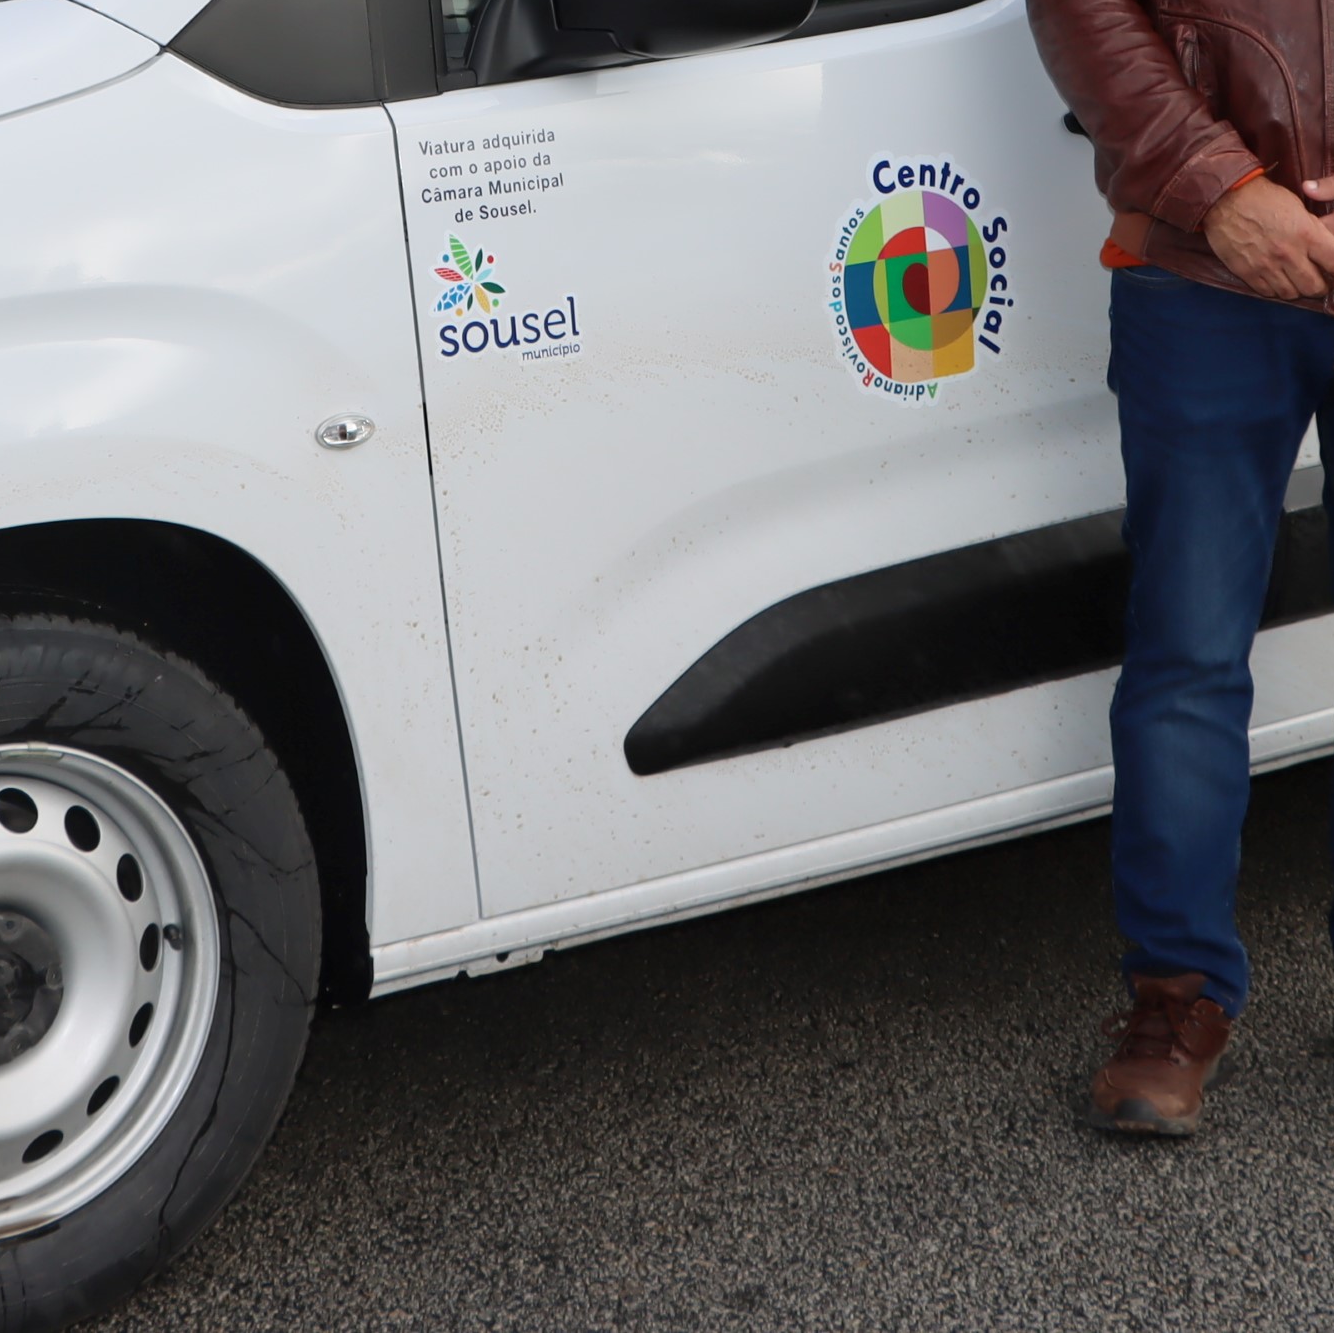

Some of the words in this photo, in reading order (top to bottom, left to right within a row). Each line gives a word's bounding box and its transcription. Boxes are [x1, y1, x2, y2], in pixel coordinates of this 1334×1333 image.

[419, 140, 475, 156] Viatura
[482, 128, 555, 149] adquirida
[429, 165, 463, 179] com
[468, 163, 478, 174] o
[484, 155, 527, 174] apoio
[532, 152, 551, 166] da
[421, 186, 483, 204] Câmara
[488, 172, 564, 195] Municipal
[873, 160, 980, 210] Centro
[454, 208, 474, 223] de
[479, 199, 537, 220] Sousel.
[979, 216, 1015, 354] Social
[439, 296, 580, 357] sousel
